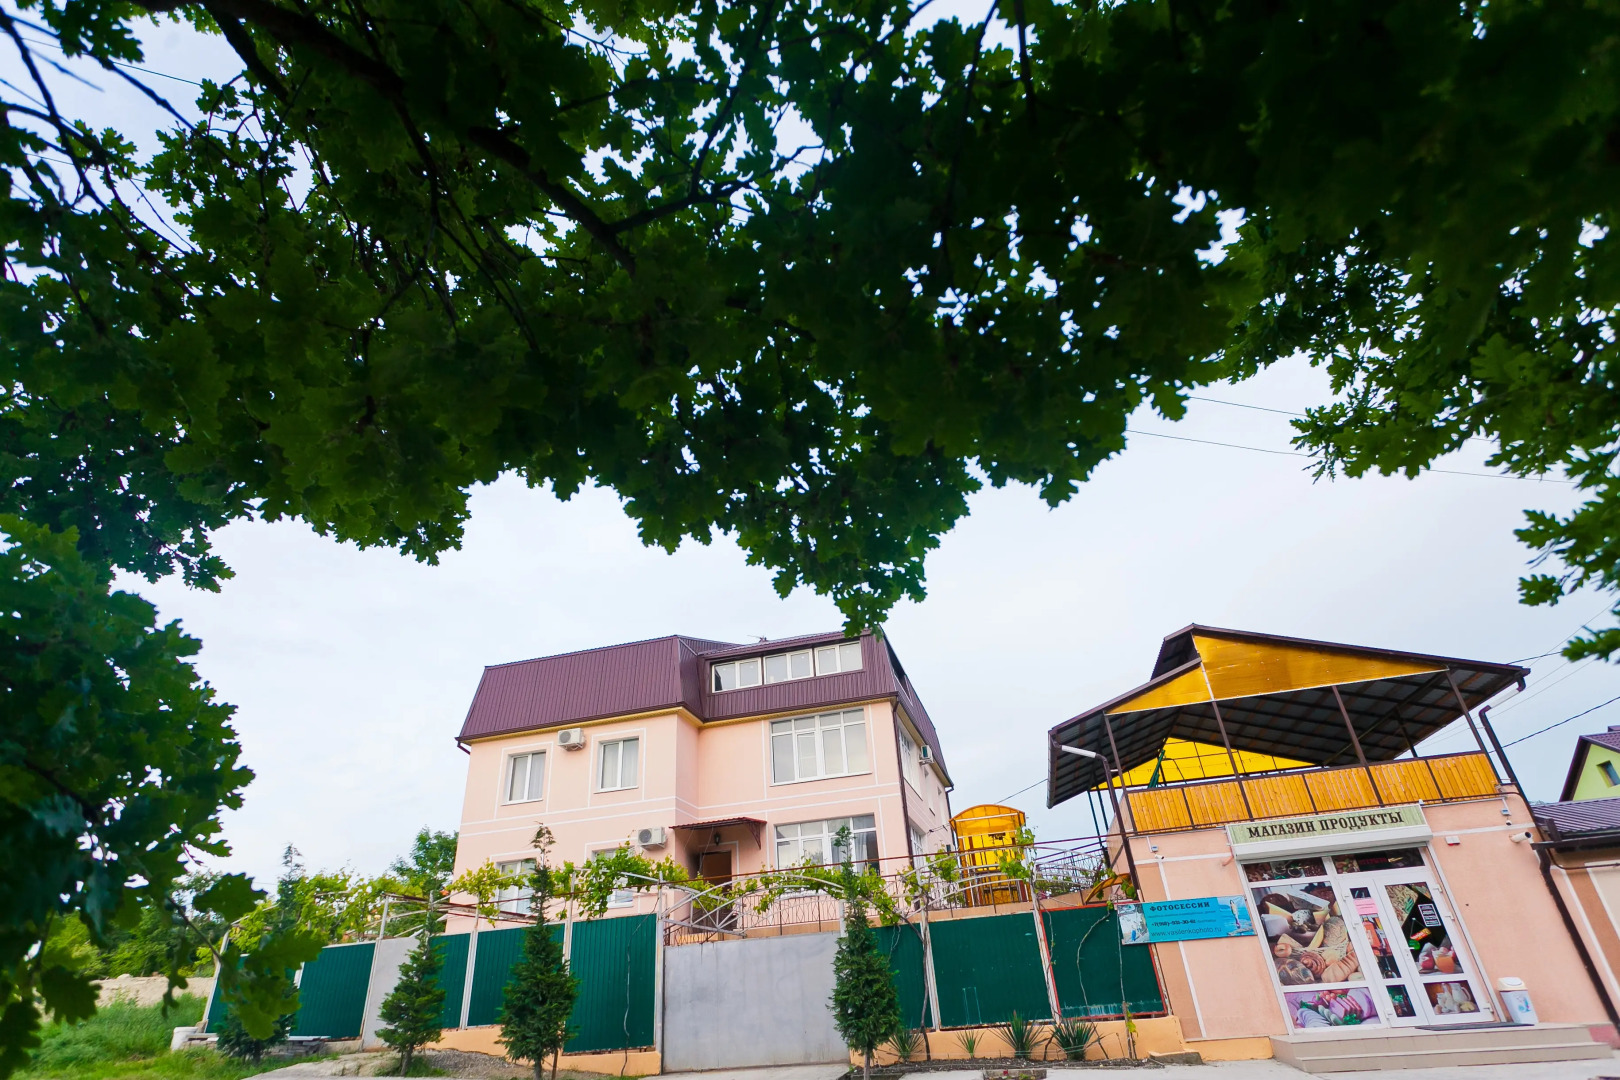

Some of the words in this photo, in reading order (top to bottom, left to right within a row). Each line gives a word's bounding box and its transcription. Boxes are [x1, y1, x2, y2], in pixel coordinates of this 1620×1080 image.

[1247, 820, 1317, 838] МАГАЗИН
[1320, 811, 1404, 831] ПРОДУКТЫ
[1149, 902, 1210, 912] ФОТОСЕССИИ
